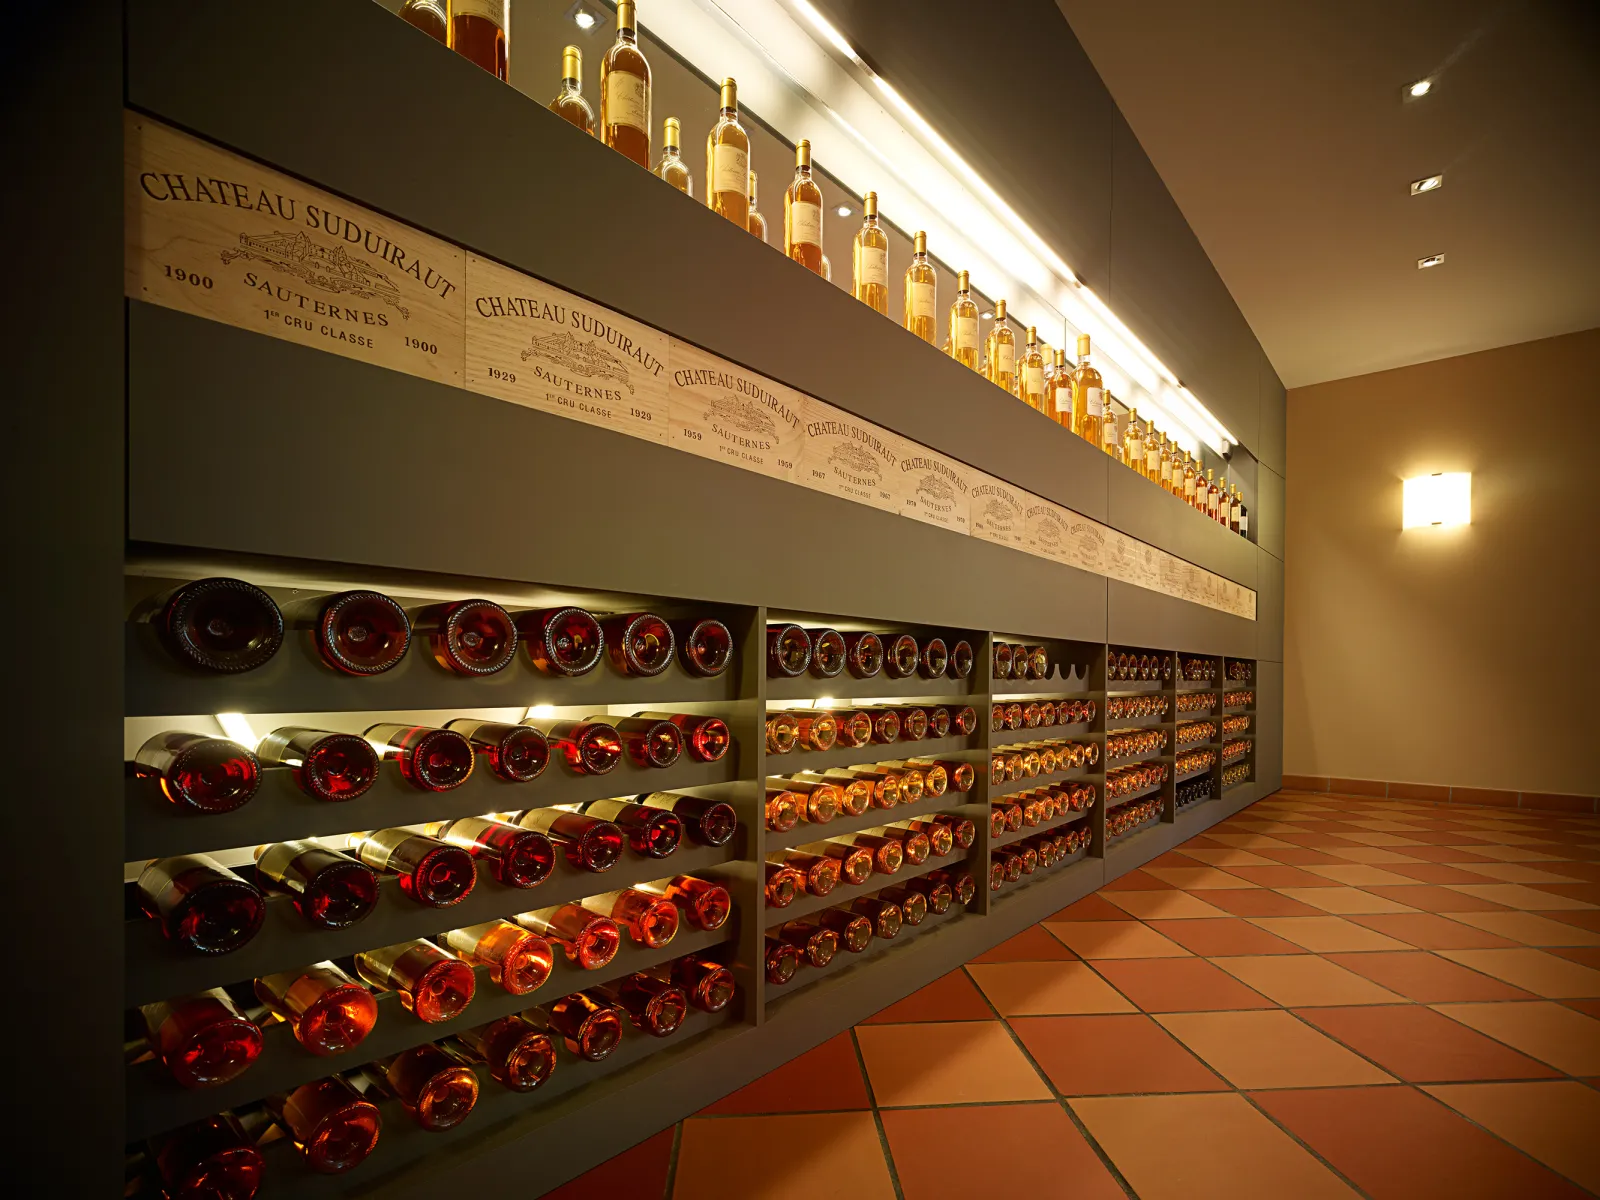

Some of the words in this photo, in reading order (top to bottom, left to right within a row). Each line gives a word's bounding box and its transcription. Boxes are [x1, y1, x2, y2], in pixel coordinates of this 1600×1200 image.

[140, 172, 296, 221] CHATEAU
[306, 205, 456, 300] SUDUIRAUT
[164, 265, 213, 290] 1900
[243, 272, 389, 327] SAUTERNES
[284, 315, 313, 331] CRU
[320, 325, 373, 349] CLASSE
[475, 297, 565, 324] CHATEAU
[571, 310, 664, 377] SUDUIRAUT
[404, 336, 438, 355] 1900
[487, 367, 516, 383] 1929
[533, 365, 622, 401] SAUTERNES
[557, 396, 575, 408] CRU
[579, 402, 612, 419] CLASSE
[674, 369, 733, 389] CHATEAU
[736, 378, 799, 430] SUDUIRAUT
[630, 408, 652, 421] 1929
[683, 428, 702, 441] 1959
[711, 423, 771, 450] SAUTERNES
[807, 421, 849, 437] CHATEAU
[851, 426, 897, 467] SUDUIRAUT
[726, 447, 739, 457] CRU
[741, 453, 764, 465] CLASSE
[777, 458, 793, 469] 1959
[833, 466, 876, 487] SAUTERNES
[900, 457, 932, 473] CHATEAU
[933, 460, 968, 495] SUDUIRAUT
